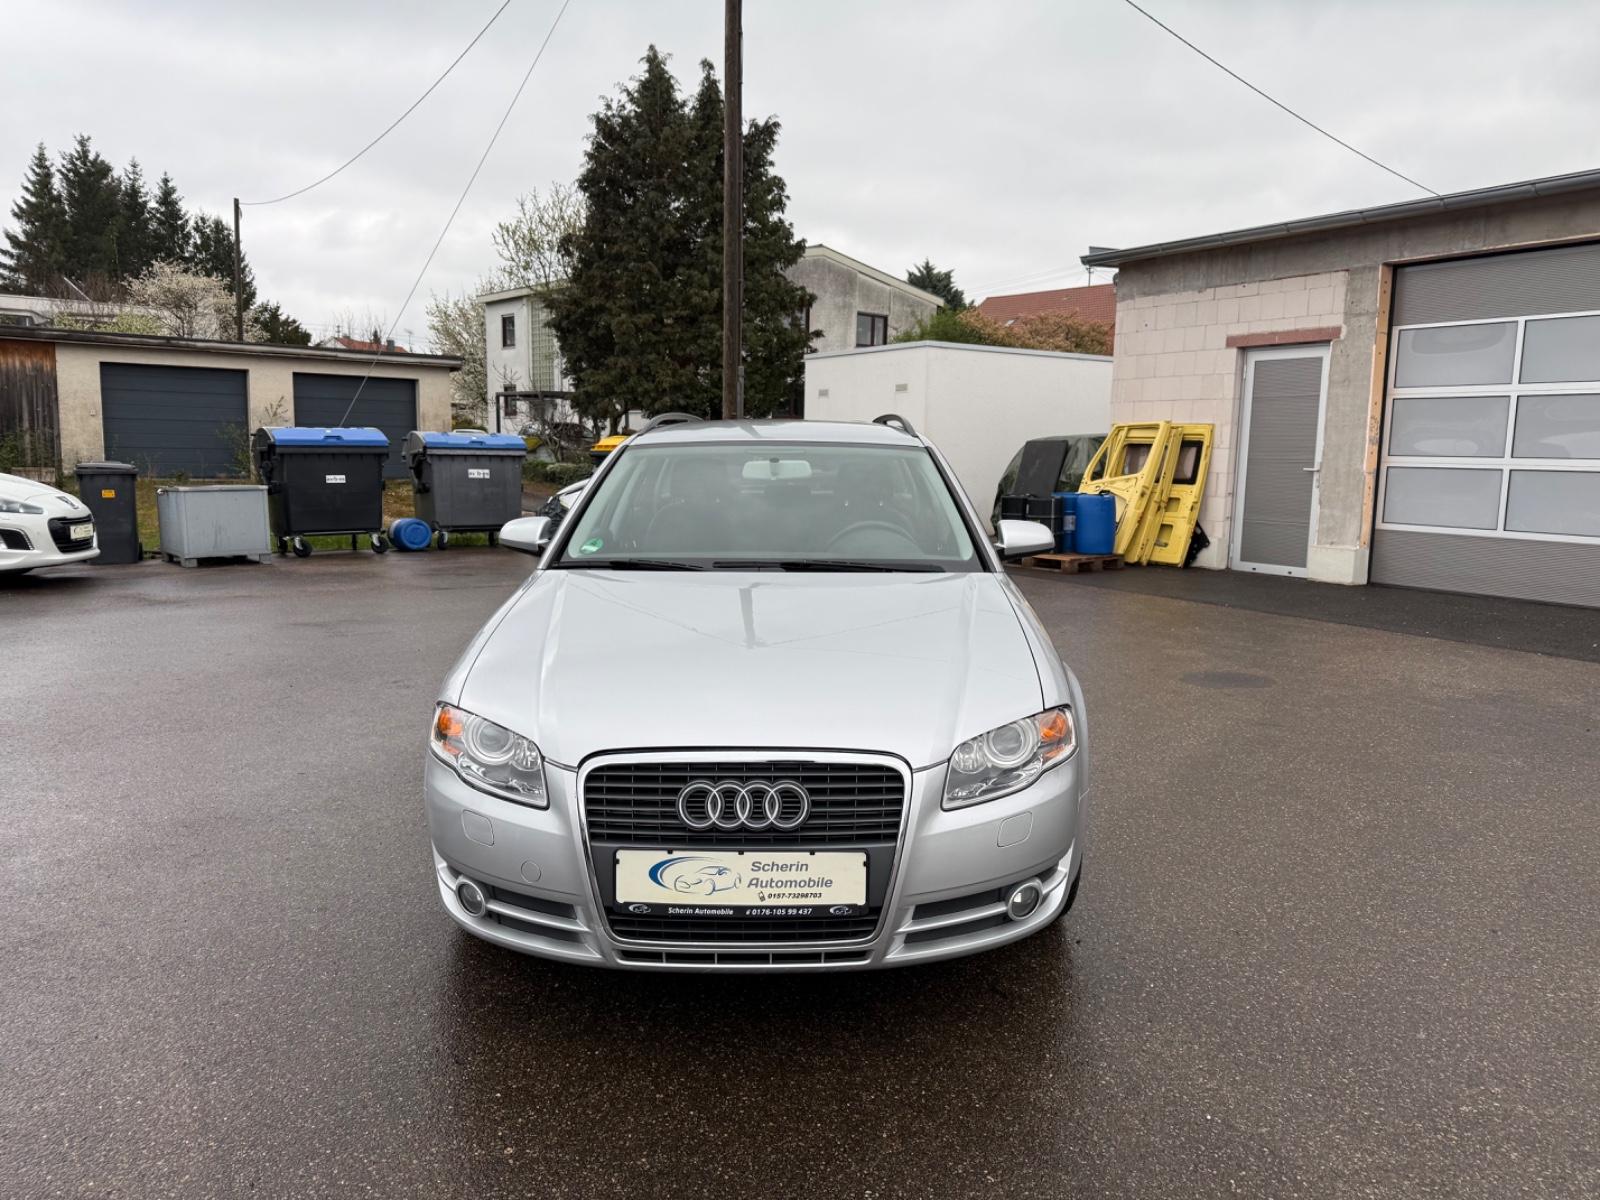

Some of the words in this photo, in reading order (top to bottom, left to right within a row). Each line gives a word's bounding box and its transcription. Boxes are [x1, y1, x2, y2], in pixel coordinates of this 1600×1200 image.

[751, 861, 809, 872] Scherin
[747, 877, 833, 889] Automobile
[694, 907, 734, 916] Automobile
